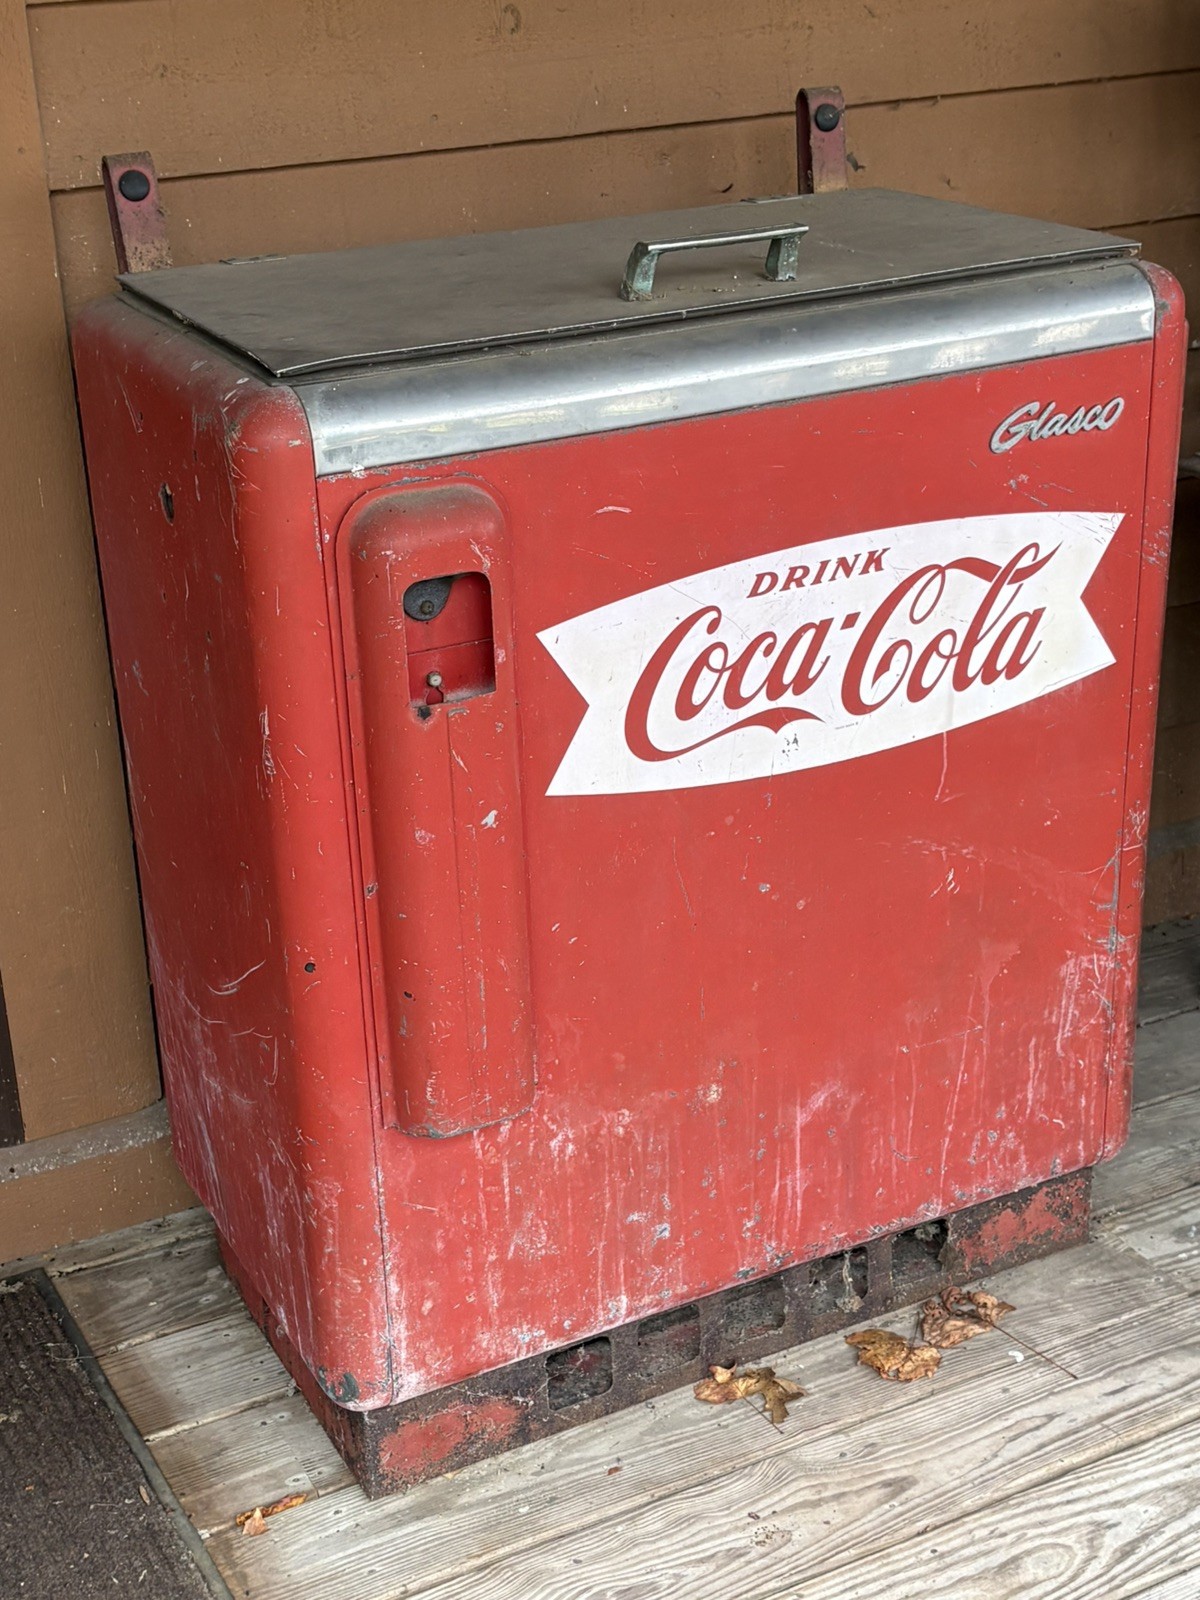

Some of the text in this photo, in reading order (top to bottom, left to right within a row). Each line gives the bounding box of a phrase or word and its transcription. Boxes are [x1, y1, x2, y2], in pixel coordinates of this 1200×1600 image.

[990, 396, 1125, 454] Glasco
[747, 547, 891, 598] DRINK
[624, 541, 1063, 762] Coca-Cola
